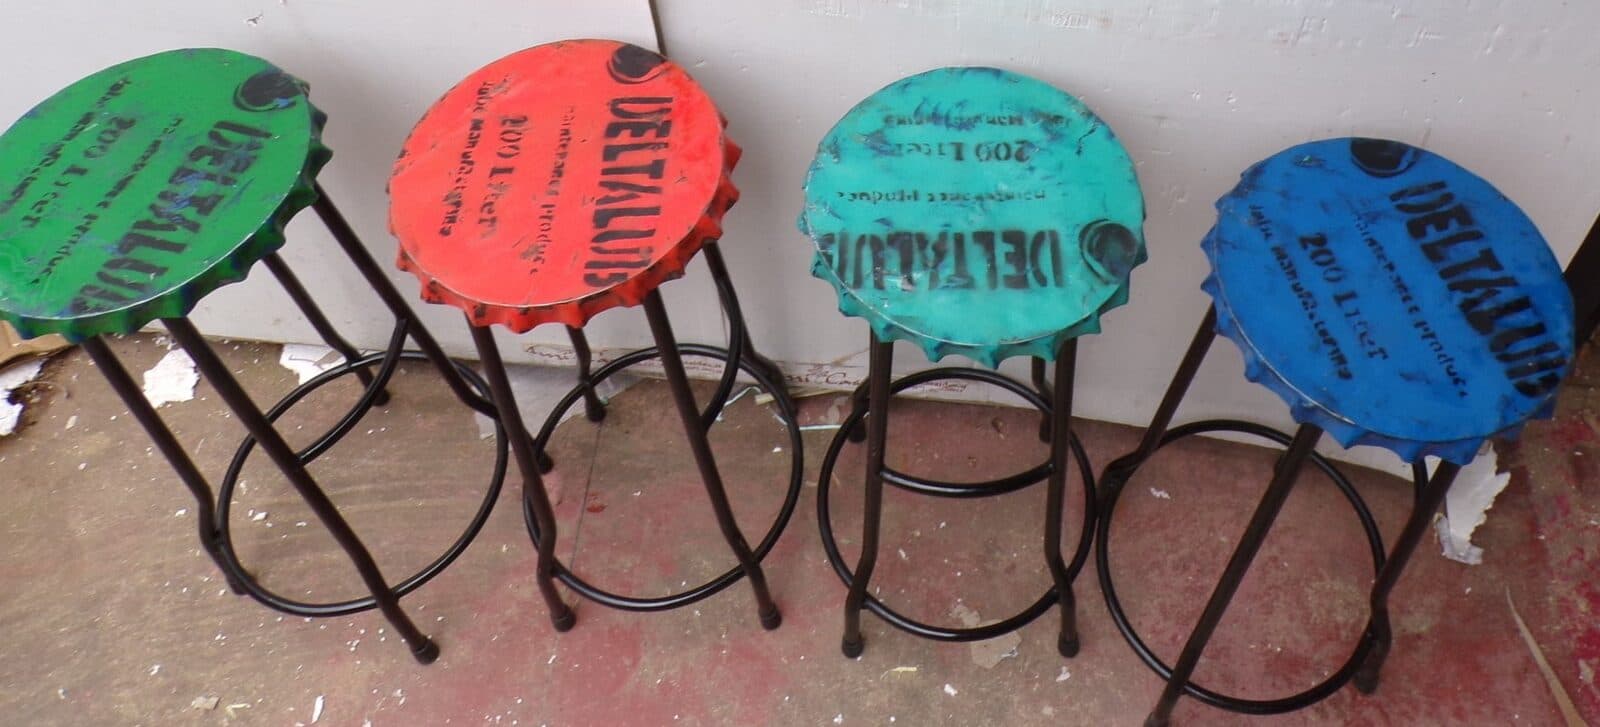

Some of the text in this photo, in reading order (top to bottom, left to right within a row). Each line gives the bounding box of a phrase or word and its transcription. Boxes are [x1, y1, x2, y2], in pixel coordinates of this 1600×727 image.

[83, 116, 137, 159] 200
[496, 115, 529, 159] 200
[974, 139, 1032, 163] 200
[1299, 232, 1344, 283] 200
